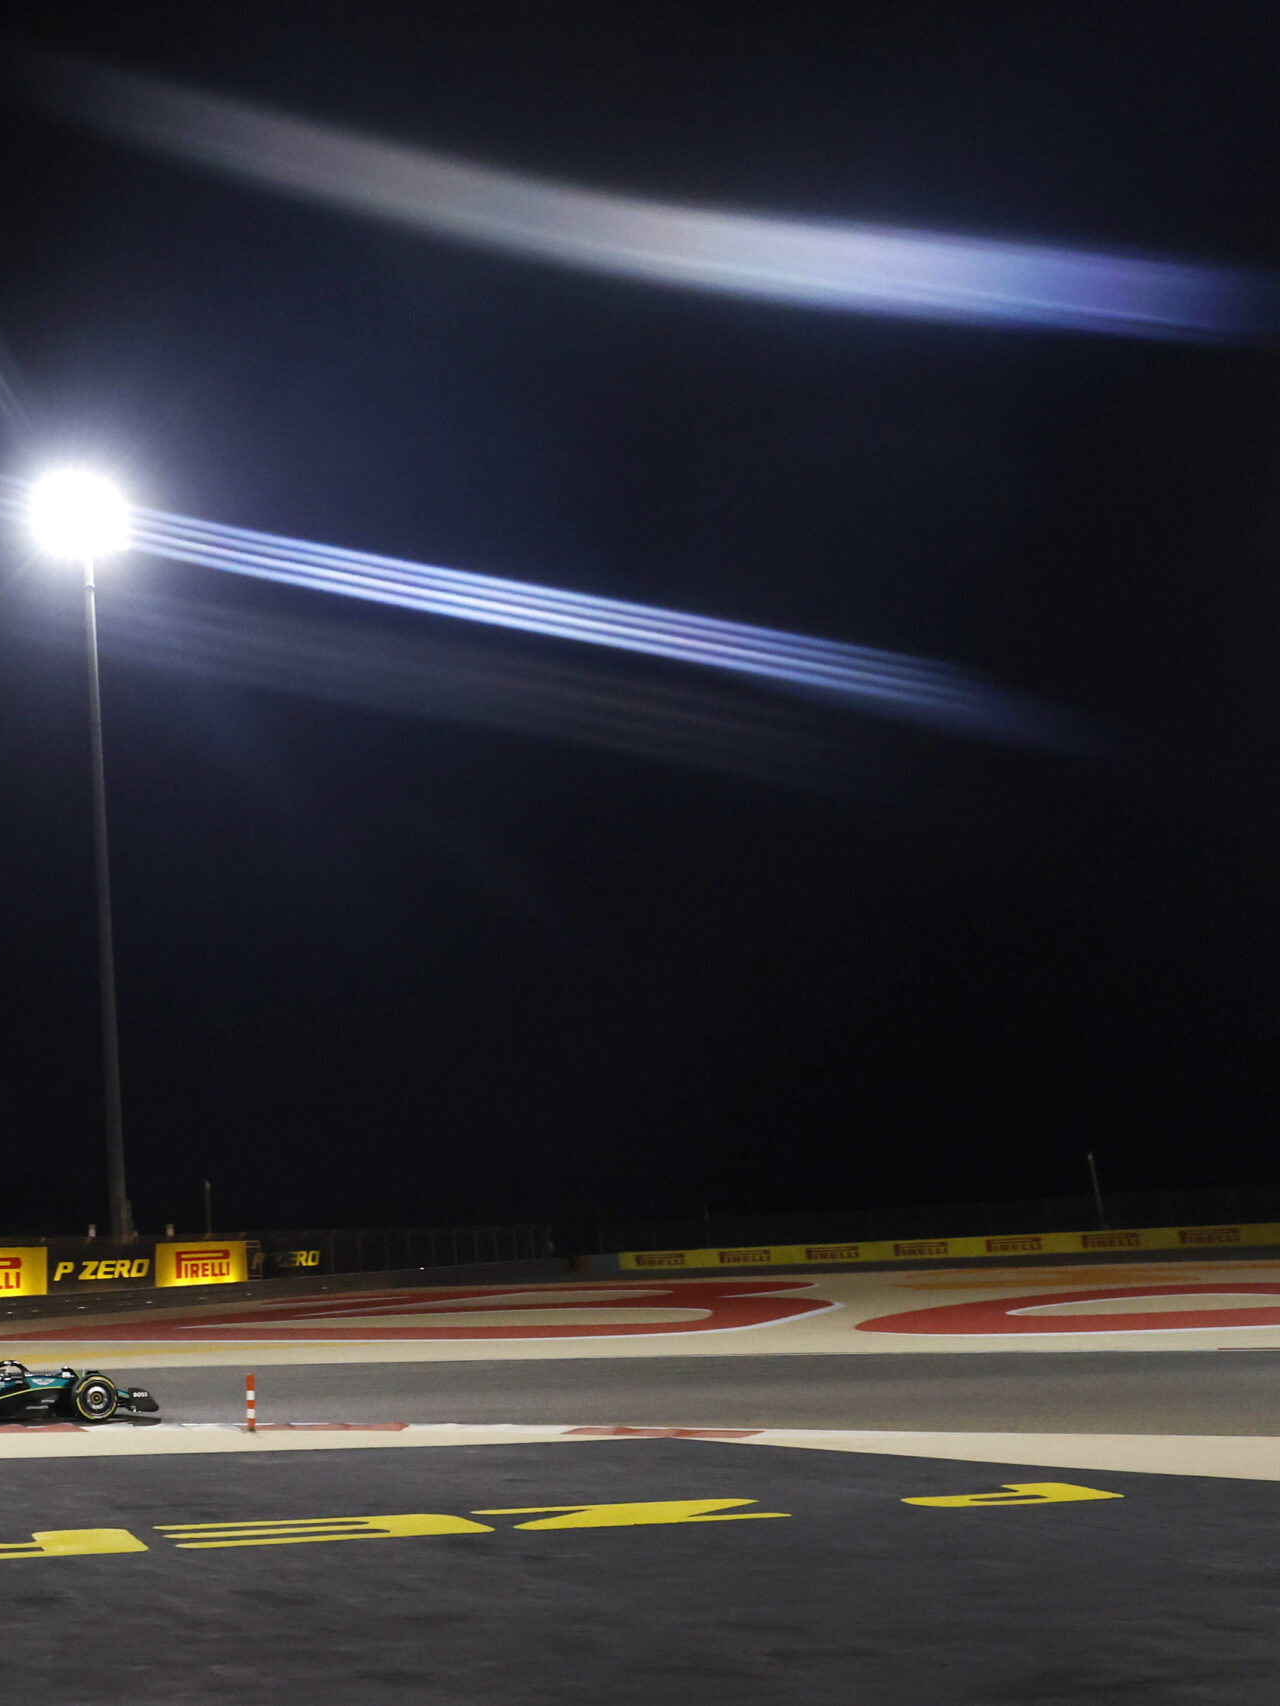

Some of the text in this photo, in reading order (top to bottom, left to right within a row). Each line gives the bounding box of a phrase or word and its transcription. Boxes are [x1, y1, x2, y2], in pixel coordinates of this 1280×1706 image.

[894, 1241, 949, 1256] PIRELLI
[985, 1237, 1042, 1253] PIRELLI
[1081, 1232, 1140, 1249] PIRELLI
[277, 1249, 320, 1268] ERO
[635, 1253, 685, 1267] PIRELLI
[719, 1249, 770, 1264] PIRELLI
[805, 1246, 860, 1260] PIRELLI
[53, 1258, 150, 1282] P ZERO
[175, 1249, 231, 1279] PIRELLI
